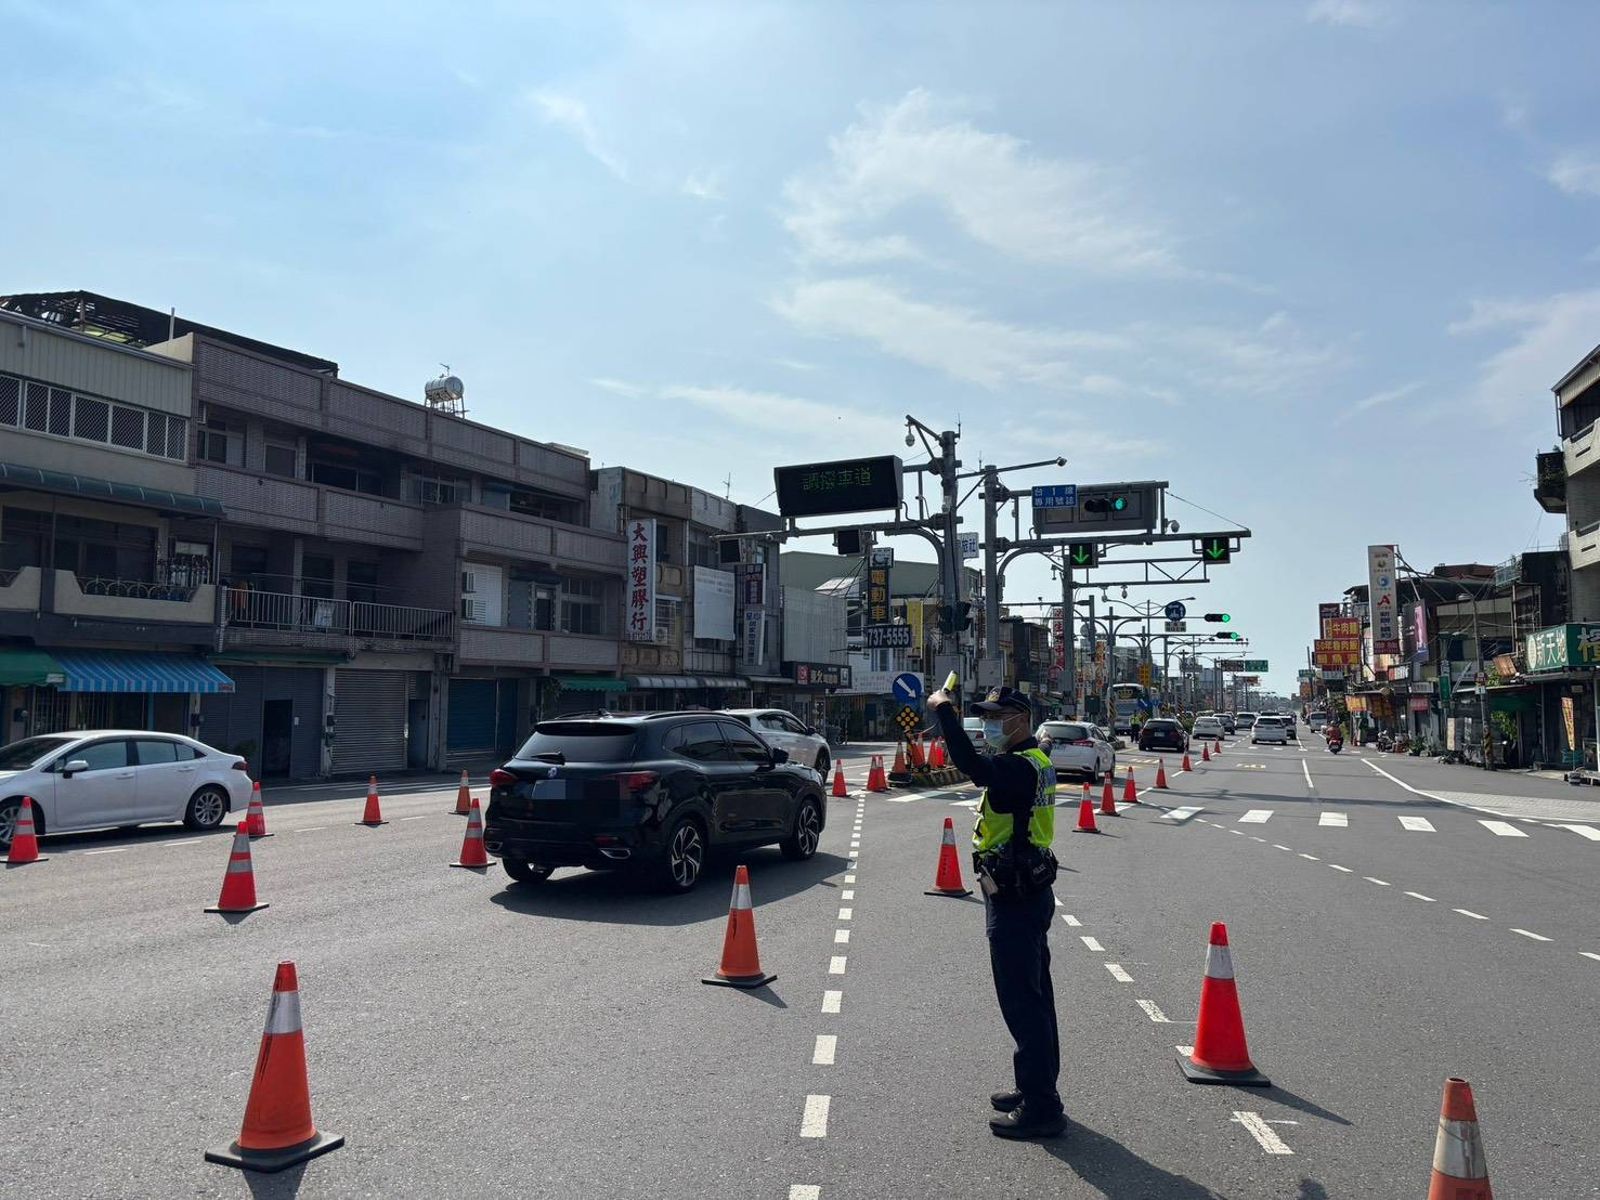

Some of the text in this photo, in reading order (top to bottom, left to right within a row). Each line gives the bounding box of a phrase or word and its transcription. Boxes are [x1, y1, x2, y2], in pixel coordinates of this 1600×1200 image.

[631, 522, 649, 632] 大興塑膠行
[870, 569, 886, 622] 電動車
[867, 627, 911, 647] 737-5555
[1536, 629, 1567, 666] 新天地
